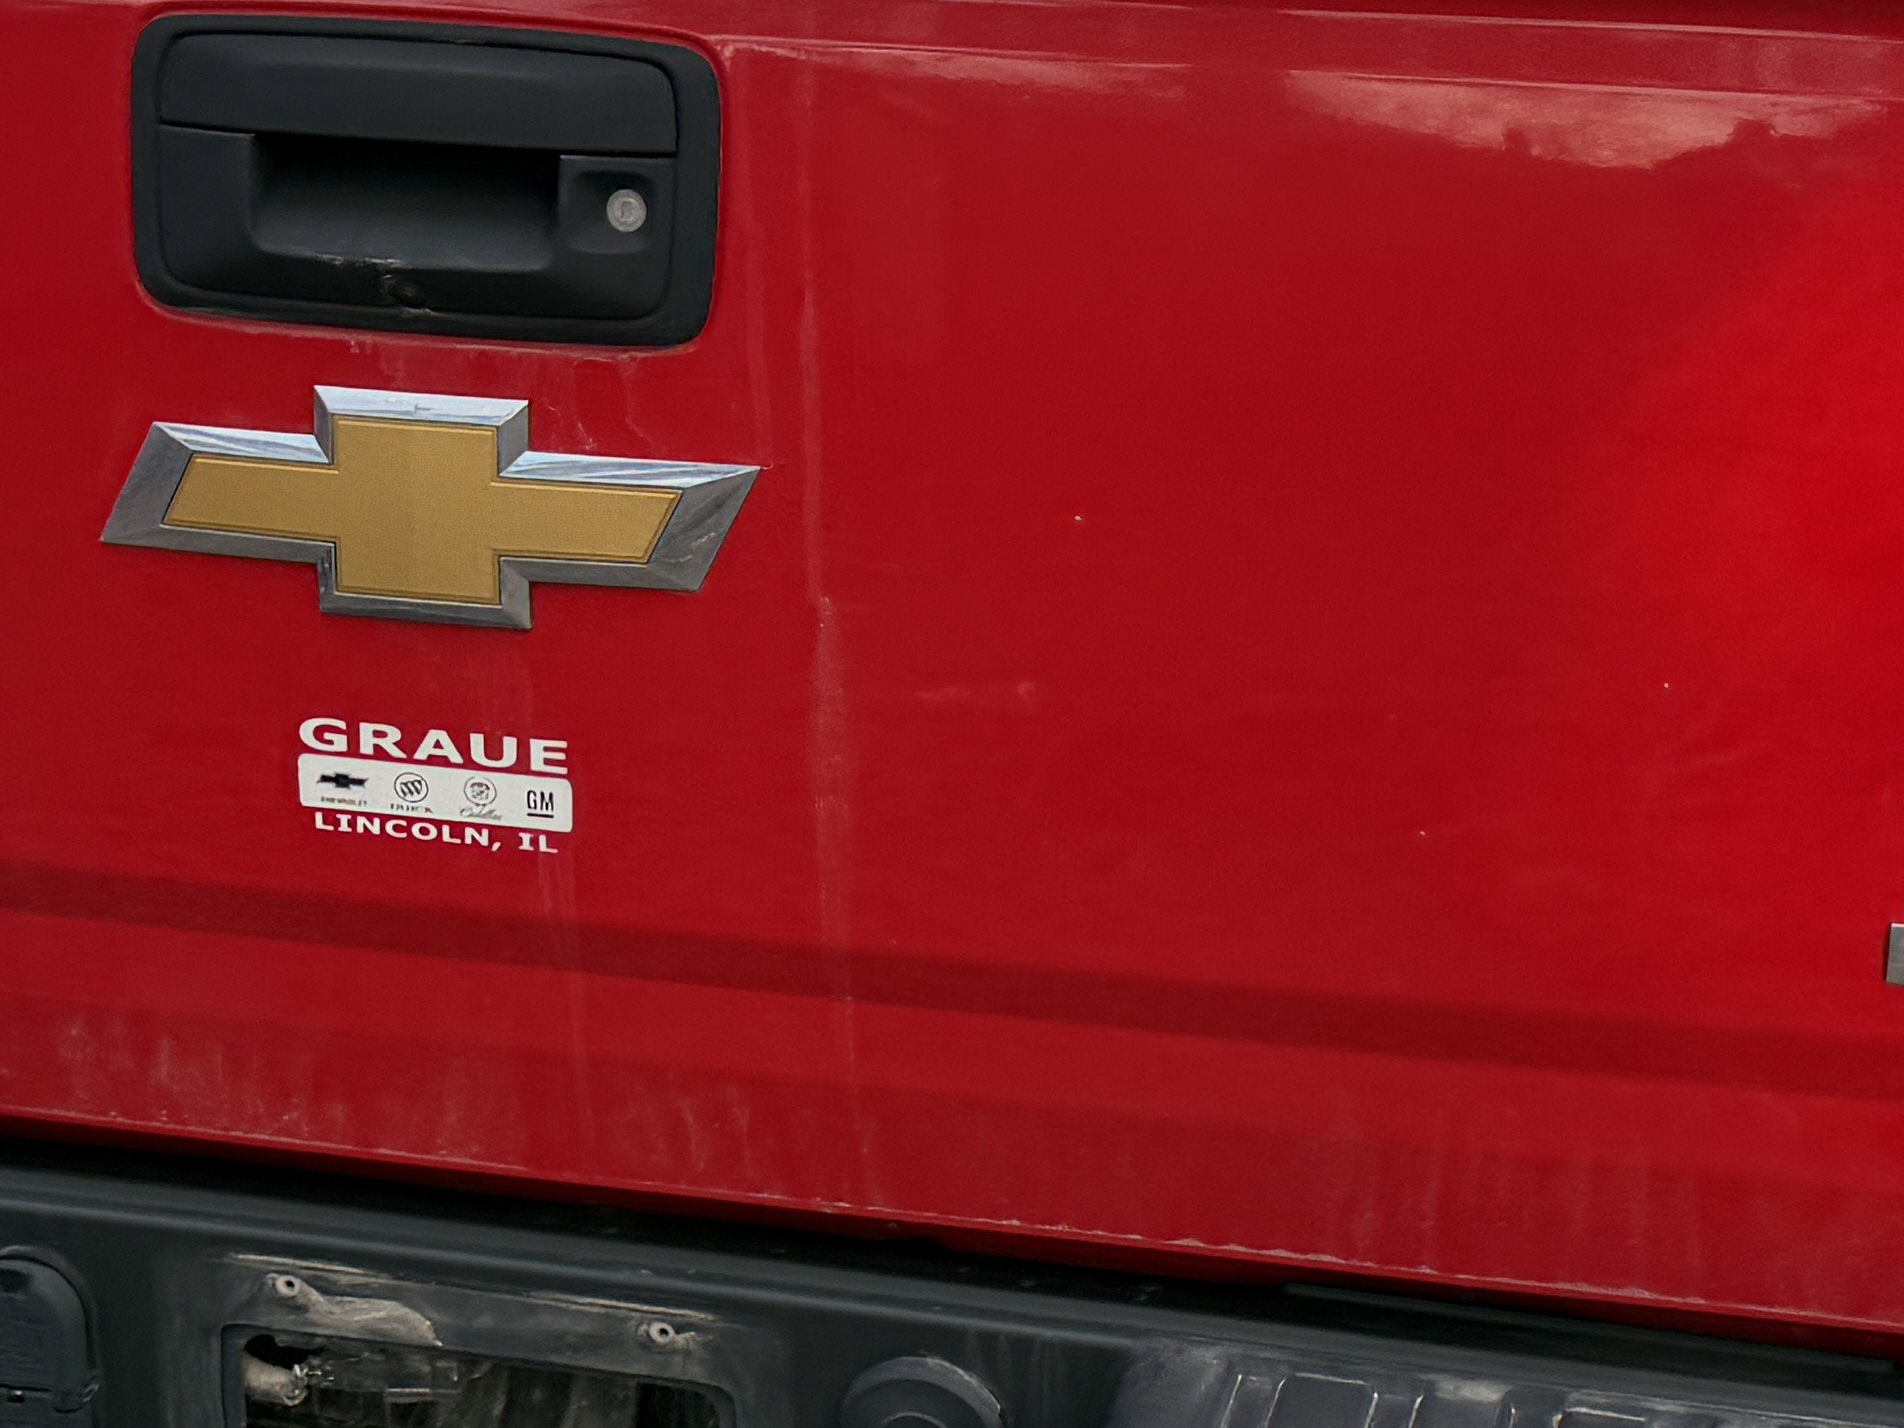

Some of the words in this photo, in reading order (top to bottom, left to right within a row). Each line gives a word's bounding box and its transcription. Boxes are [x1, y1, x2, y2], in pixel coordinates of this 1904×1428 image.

[298, 717, 569, 775] GRAUE
[526, 788, 555, 813] GM
[314, 811, 502, 852] LINCOLN,
[517, 831, 559, 854] IL
